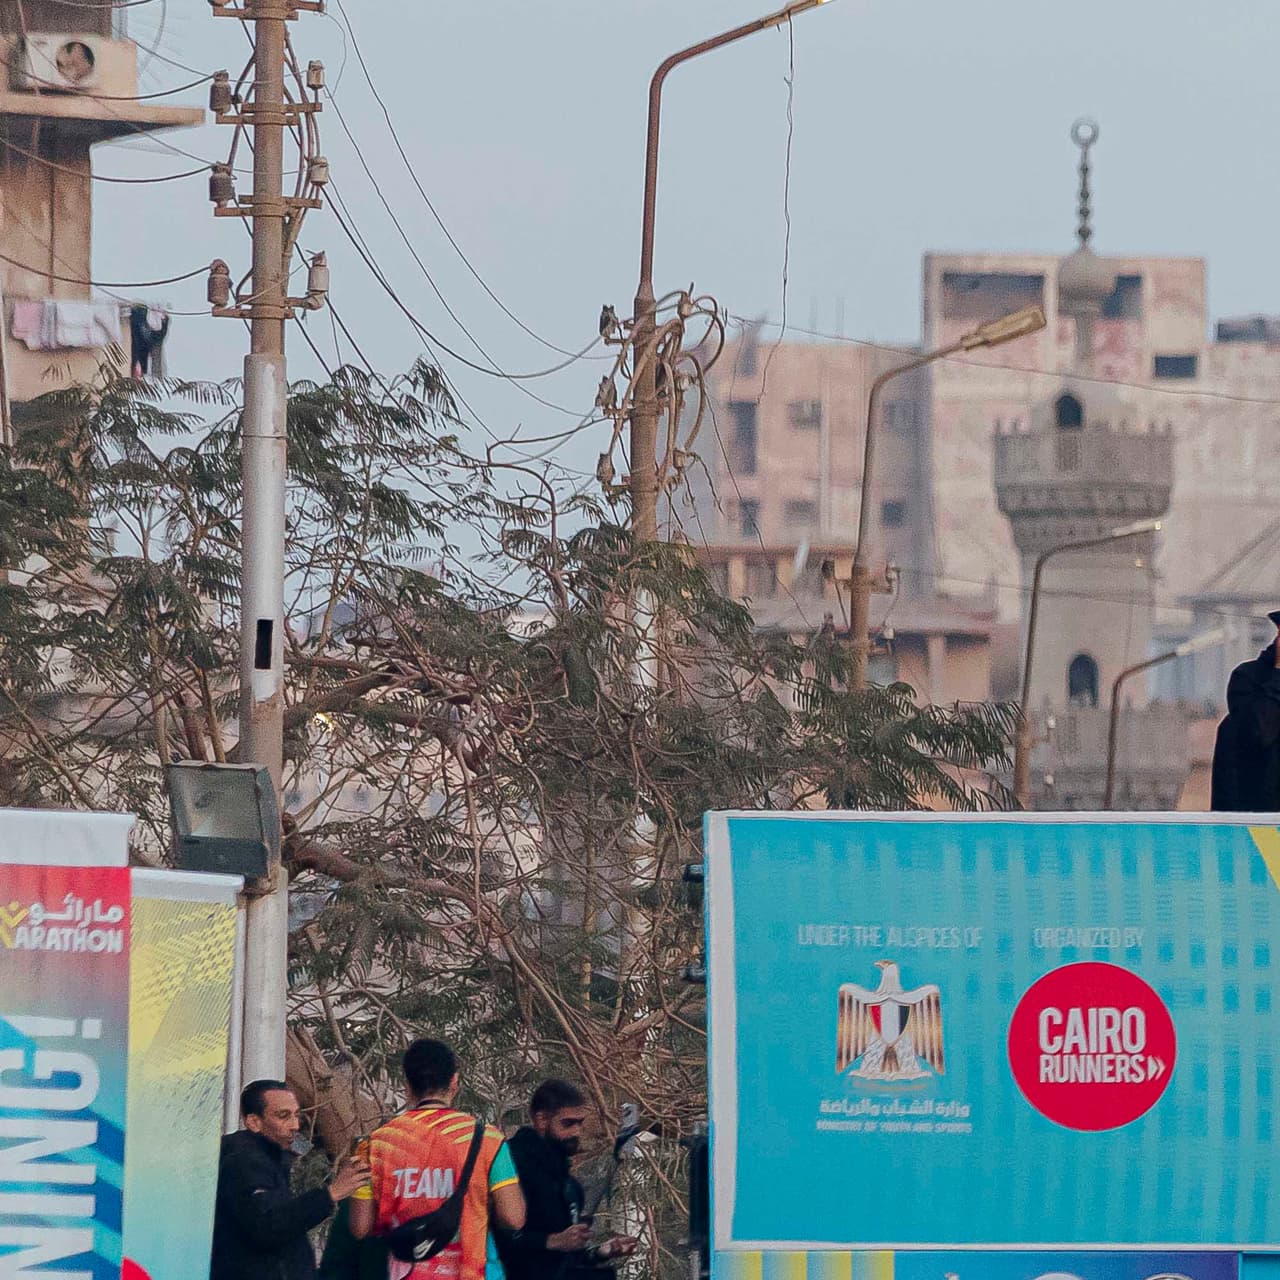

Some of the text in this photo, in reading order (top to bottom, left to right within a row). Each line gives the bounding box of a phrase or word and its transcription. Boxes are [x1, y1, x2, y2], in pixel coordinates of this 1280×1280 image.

[853, 925, 881, 947] THE
[964, 927, 982, 948] OF
[1124, 927, 1145, 948] BY
[1039, 1006, 1147, 1054] CAIRO
[1039, 1054, 1146, 1084] RUNNERS
[392, 1167, 455, 1199] TEAM
